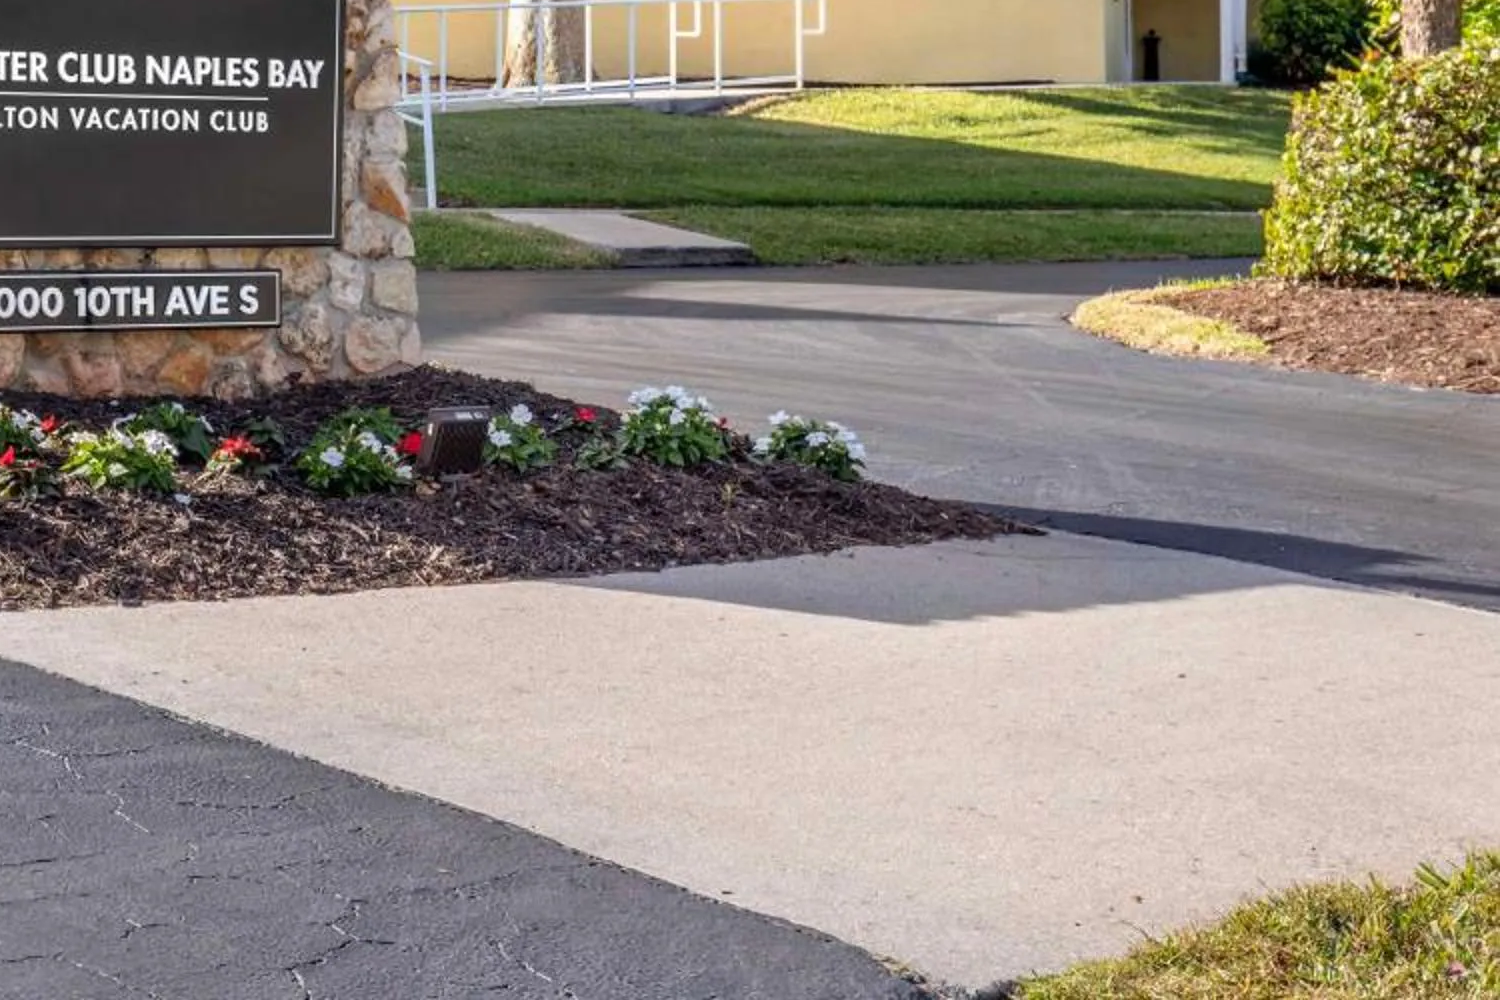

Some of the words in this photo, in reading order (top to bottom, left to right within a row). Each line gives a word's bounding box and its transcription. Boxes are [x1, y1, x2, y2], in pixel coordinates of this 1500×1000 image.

[57, 51, 137, 85] CLUB
[145, 55, 260, 88] NAPLES
[267, 58, 325, 89] BAY
[69, 107, 200, 132] VACATION
[209, 109, 269, 133] CLUB
[73, 285, 155, 317] 10TH
[163, 285, 230, 316] AVE
[239, 284, 259, 315] S
